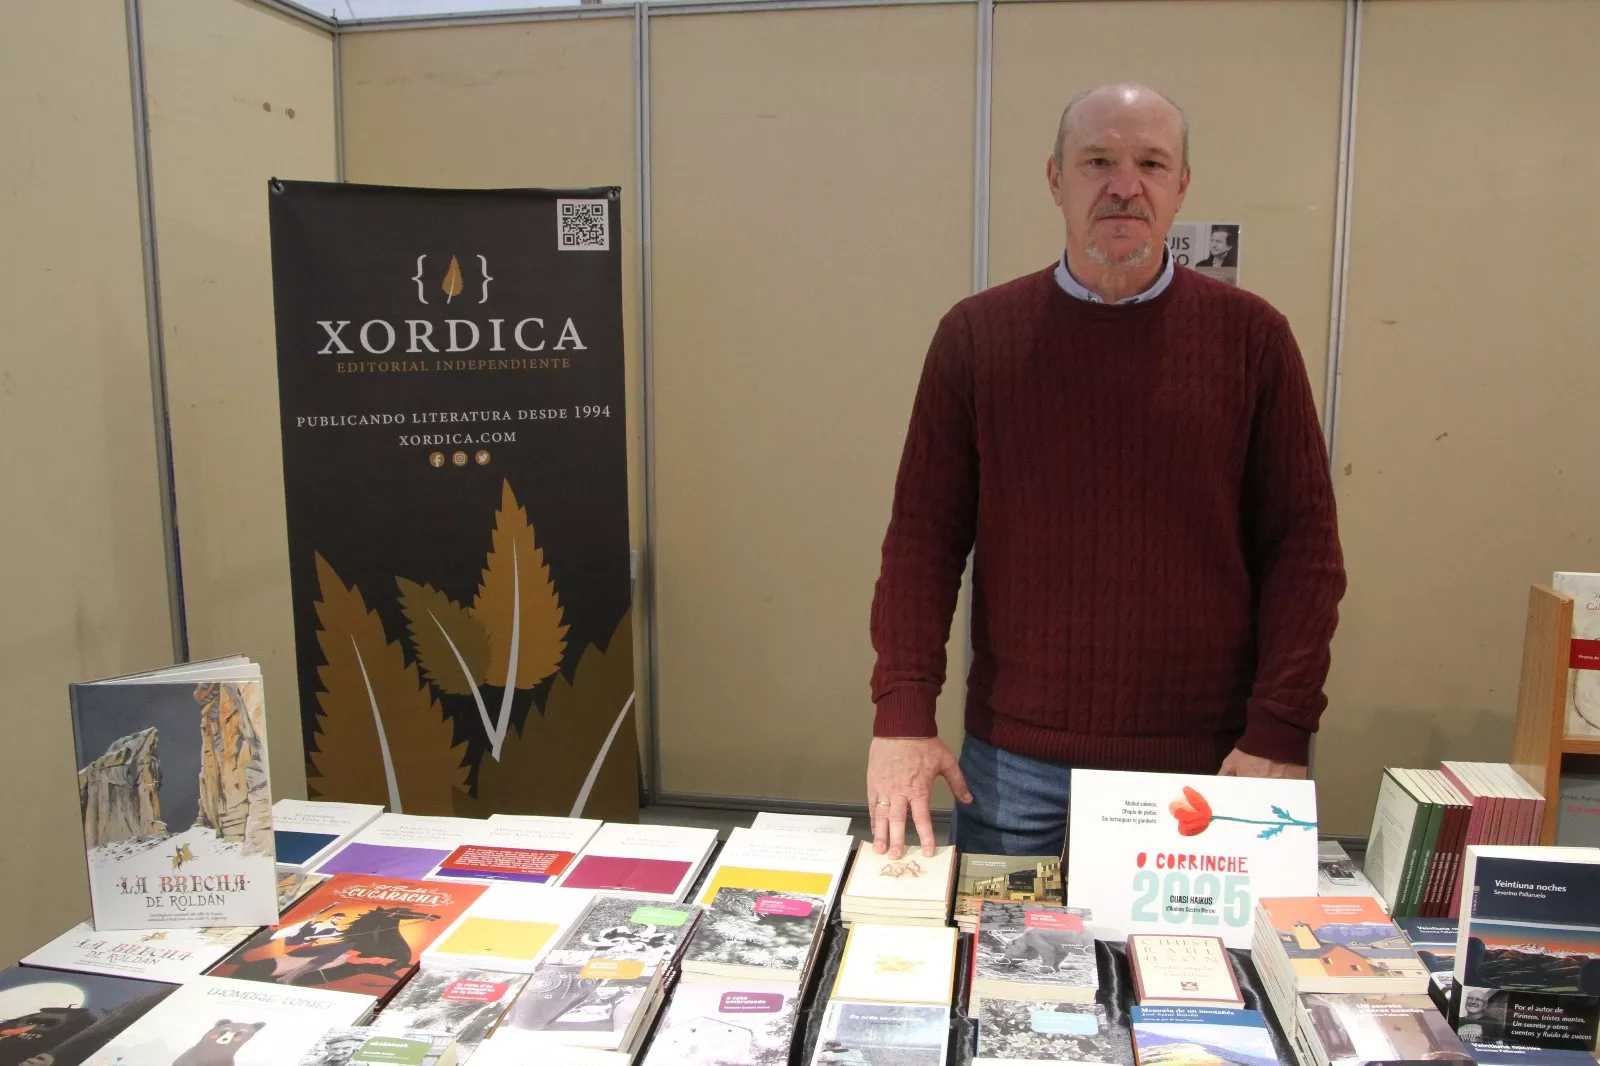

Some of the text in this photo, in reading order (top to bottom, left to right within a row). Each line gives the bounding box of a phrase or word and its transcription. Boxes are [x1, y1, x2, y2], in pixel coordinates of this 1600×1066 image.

[316, 317, 588, 355] XORDICA
[336, 357, 571, 374] EDITORIAL INDEPENDIENTE
[296, 404, 612, 428] PUBLICANDO LITERATURA DESDE 1994
[398, 431, 517, 447] XORDICA.COM
[1137, 852, 1249, 874] O CORRINCHE
[119, 872, 248, 896] LA BRECHA
[1494, 879, 1568, 893] Veintiuna noches
[347, 888, 441, 905] CUCARACHA
[1131, 869, 1251, 928] 2025
[1189, 896, 1213, 906] HAIKUS
[1493, 888, 1546, 900] Severino Pallaruelo
[145, 892, 226, 912] DE ROLDÁN
[86, 950, 106, 960] DE
[109, 943, 193, 961] BRECHA
[1198, 1008, 1235, 1016] montañés
[1514, 1003, 1564, 1014] Por el autor de
[1512, 1020, 1522, 1028] Un
[1523, 1021, 1546, 1030] secreto
[1513, 1011, 1586, 1024] Pirineos, tristes montes,
[1511, 1029, 1535, 1038] cuentos
[1542, 1030, 1561, 1039] Ruido
[1561, 1032, 1570, 1040] de
[1570, 1034, 1593, 1042] zuecos
[1471, 1042, 1511, 1050] Veintiuna
